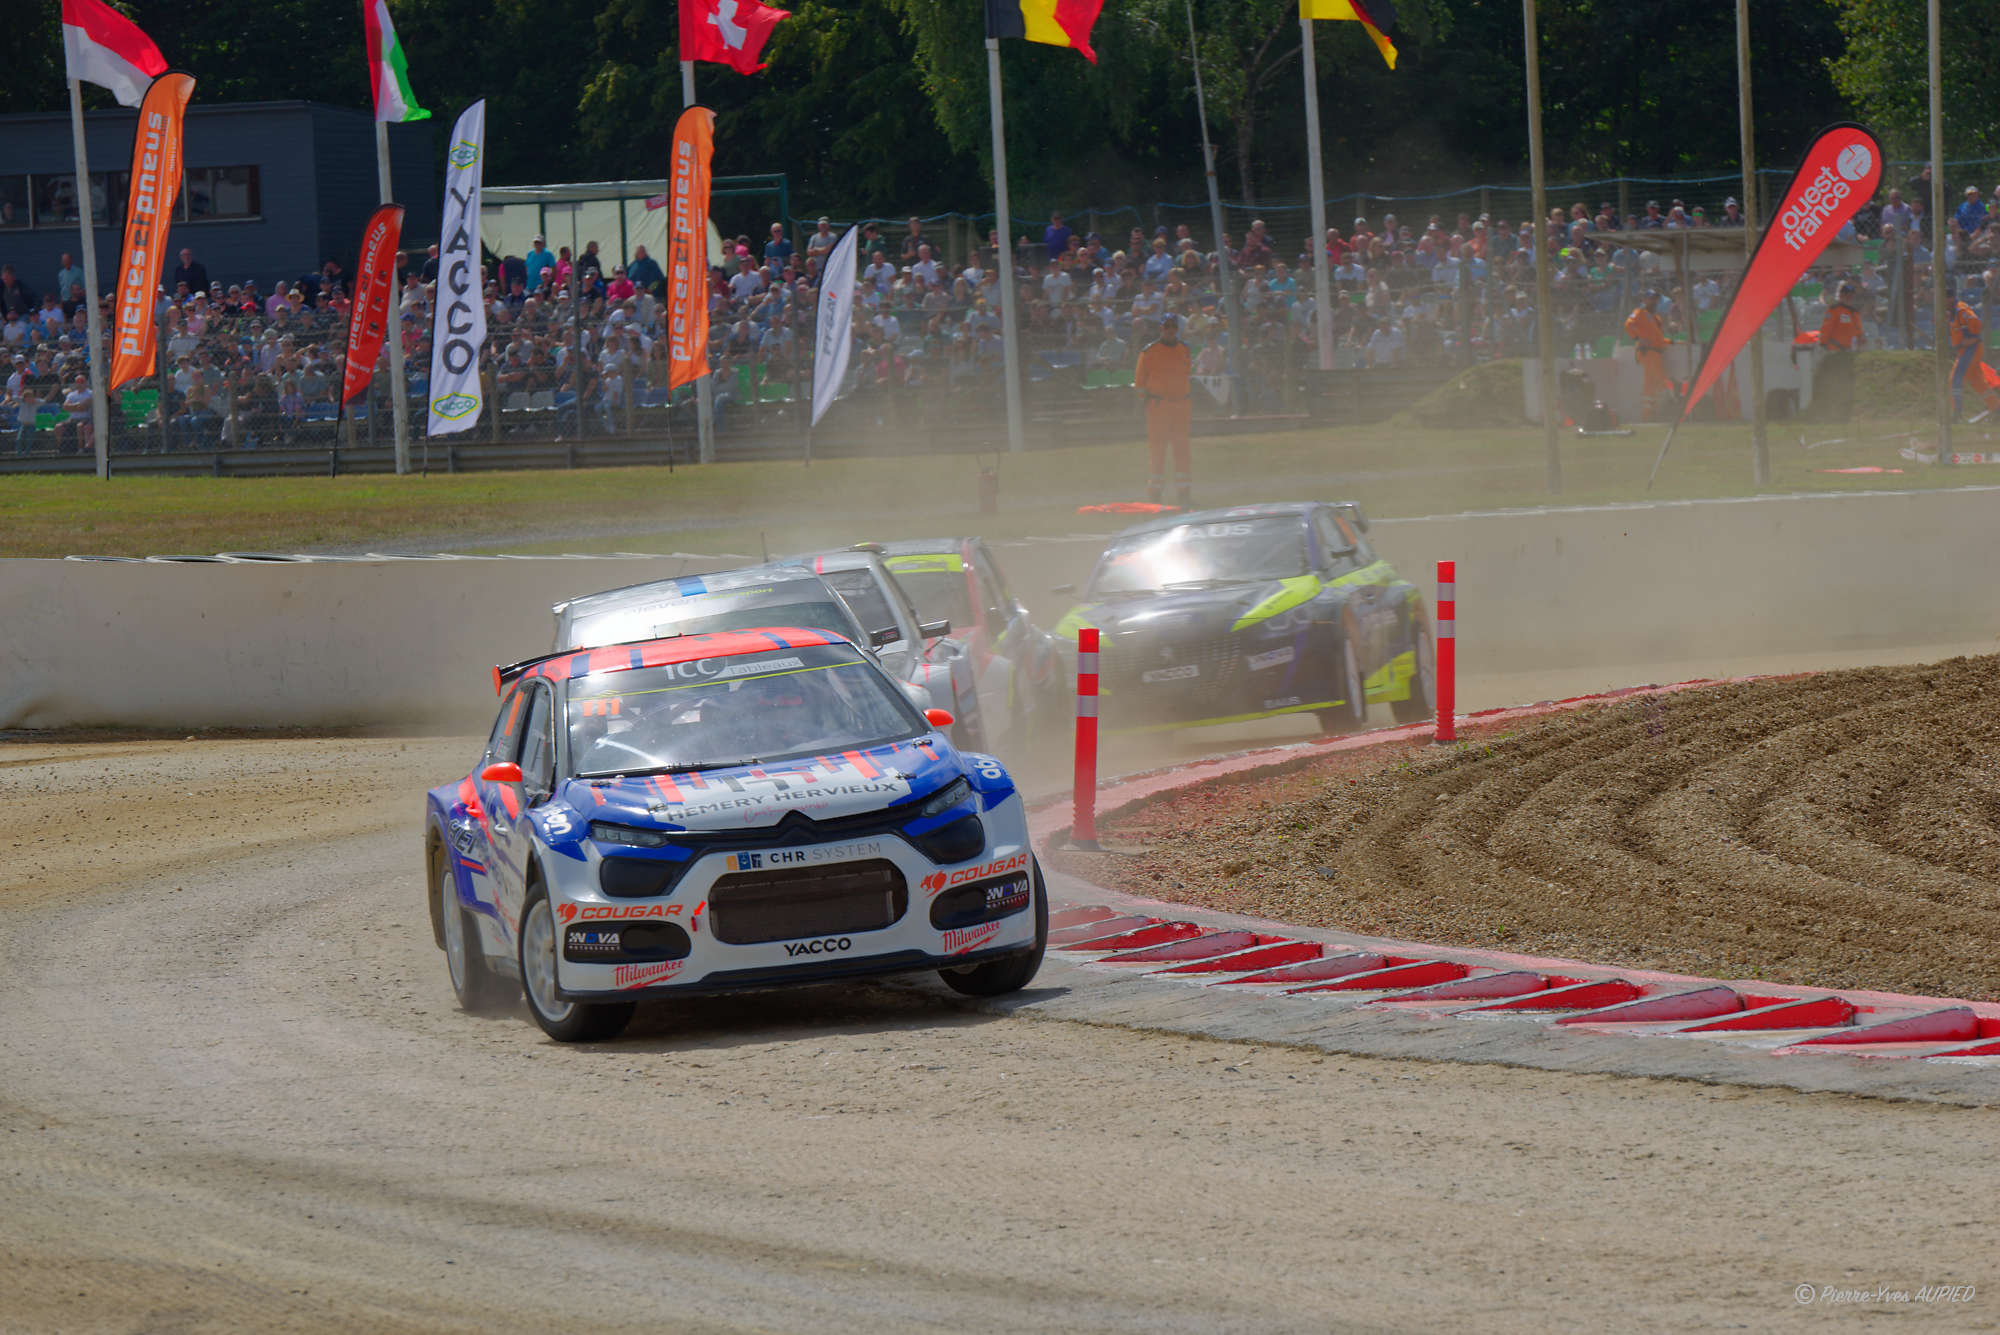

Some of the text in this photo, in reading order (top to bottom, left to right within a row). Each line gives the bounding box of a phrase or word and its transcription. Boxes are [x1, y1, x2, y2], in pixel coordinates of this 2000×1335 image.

[1781, 166, 1840, 230] ouest
[1783, 181, 1850, 250] france
[442, 186, 475, 375] YACCO
[667, 794, 766, 822] HEMERY
[774, 782, 898, 802] HERVIEUX
[770, 851, 806, 864] CHR
[812, 842, 882, 860] SYSTEM
[950, 853, 1027, 885] COUGAR
[581, 904, 683, 919] COUGAR
[784, 937, 851, 957] YACCO
[942, 921, 1000, 953] Milwaukee
[610, 960, 684, 986] Milwaukee
